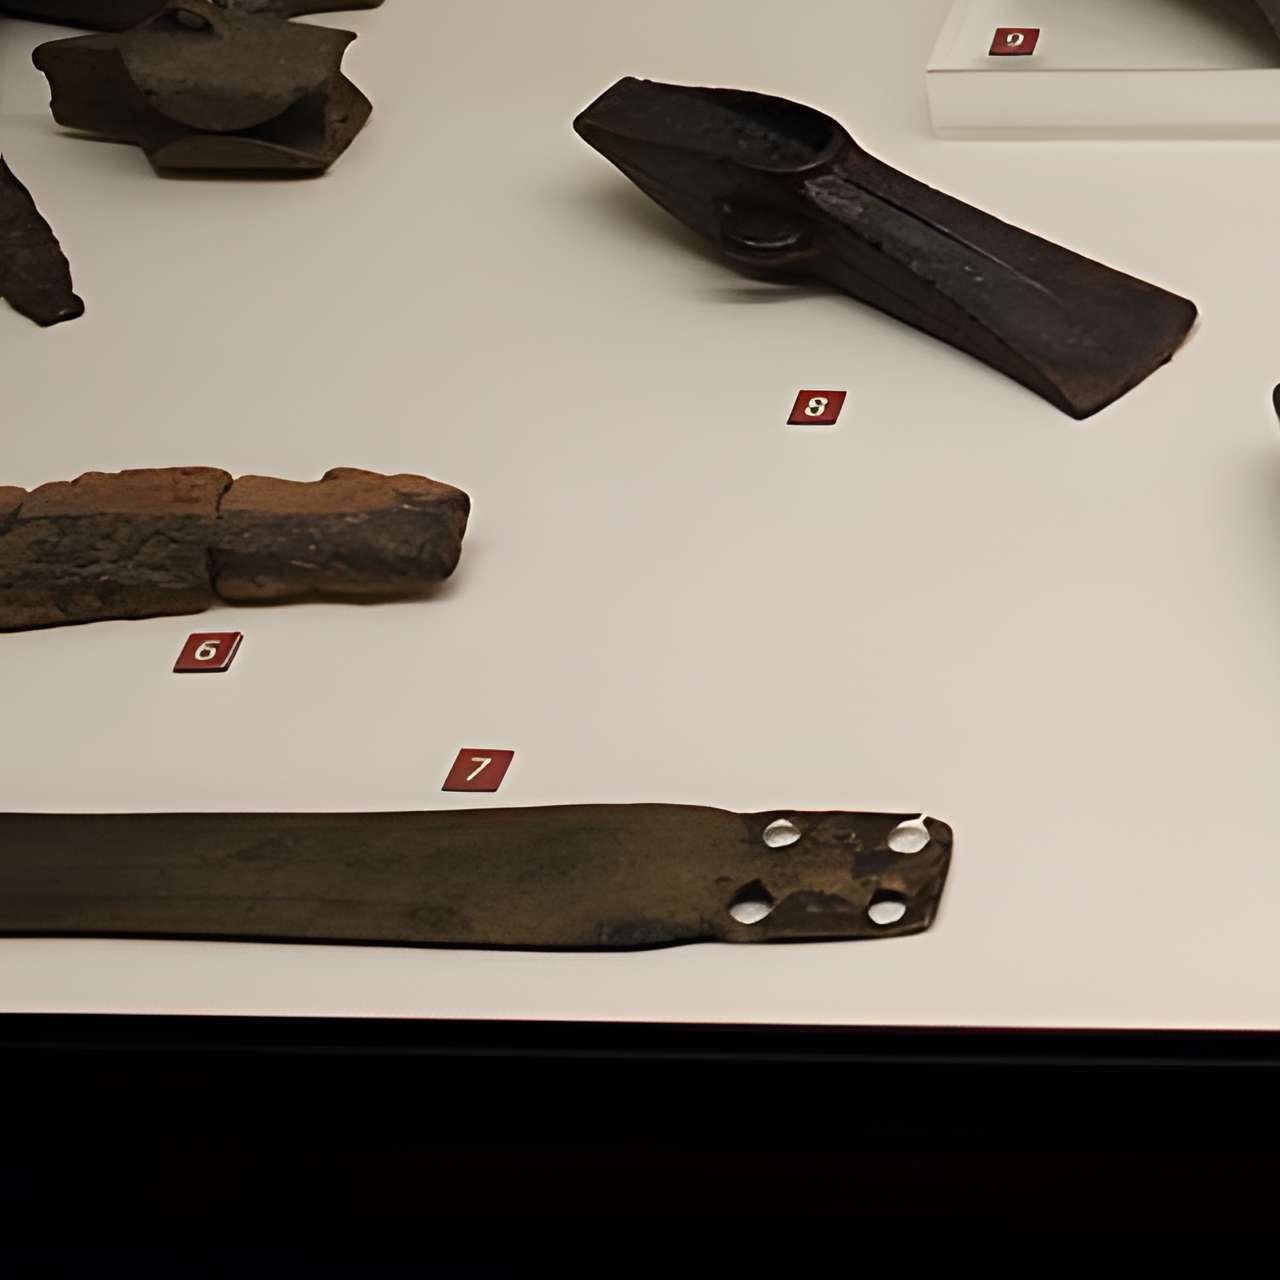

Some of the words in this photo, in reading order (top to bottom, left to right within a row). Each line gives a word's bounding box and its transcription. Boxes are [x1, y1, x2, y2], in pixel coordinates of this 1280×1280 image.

[1006, 32, 1025, 47] 9
[804, 396, 829, 417] 8
[194, 639, 221, 661] 6
[466, 757, 492, 781] 7
